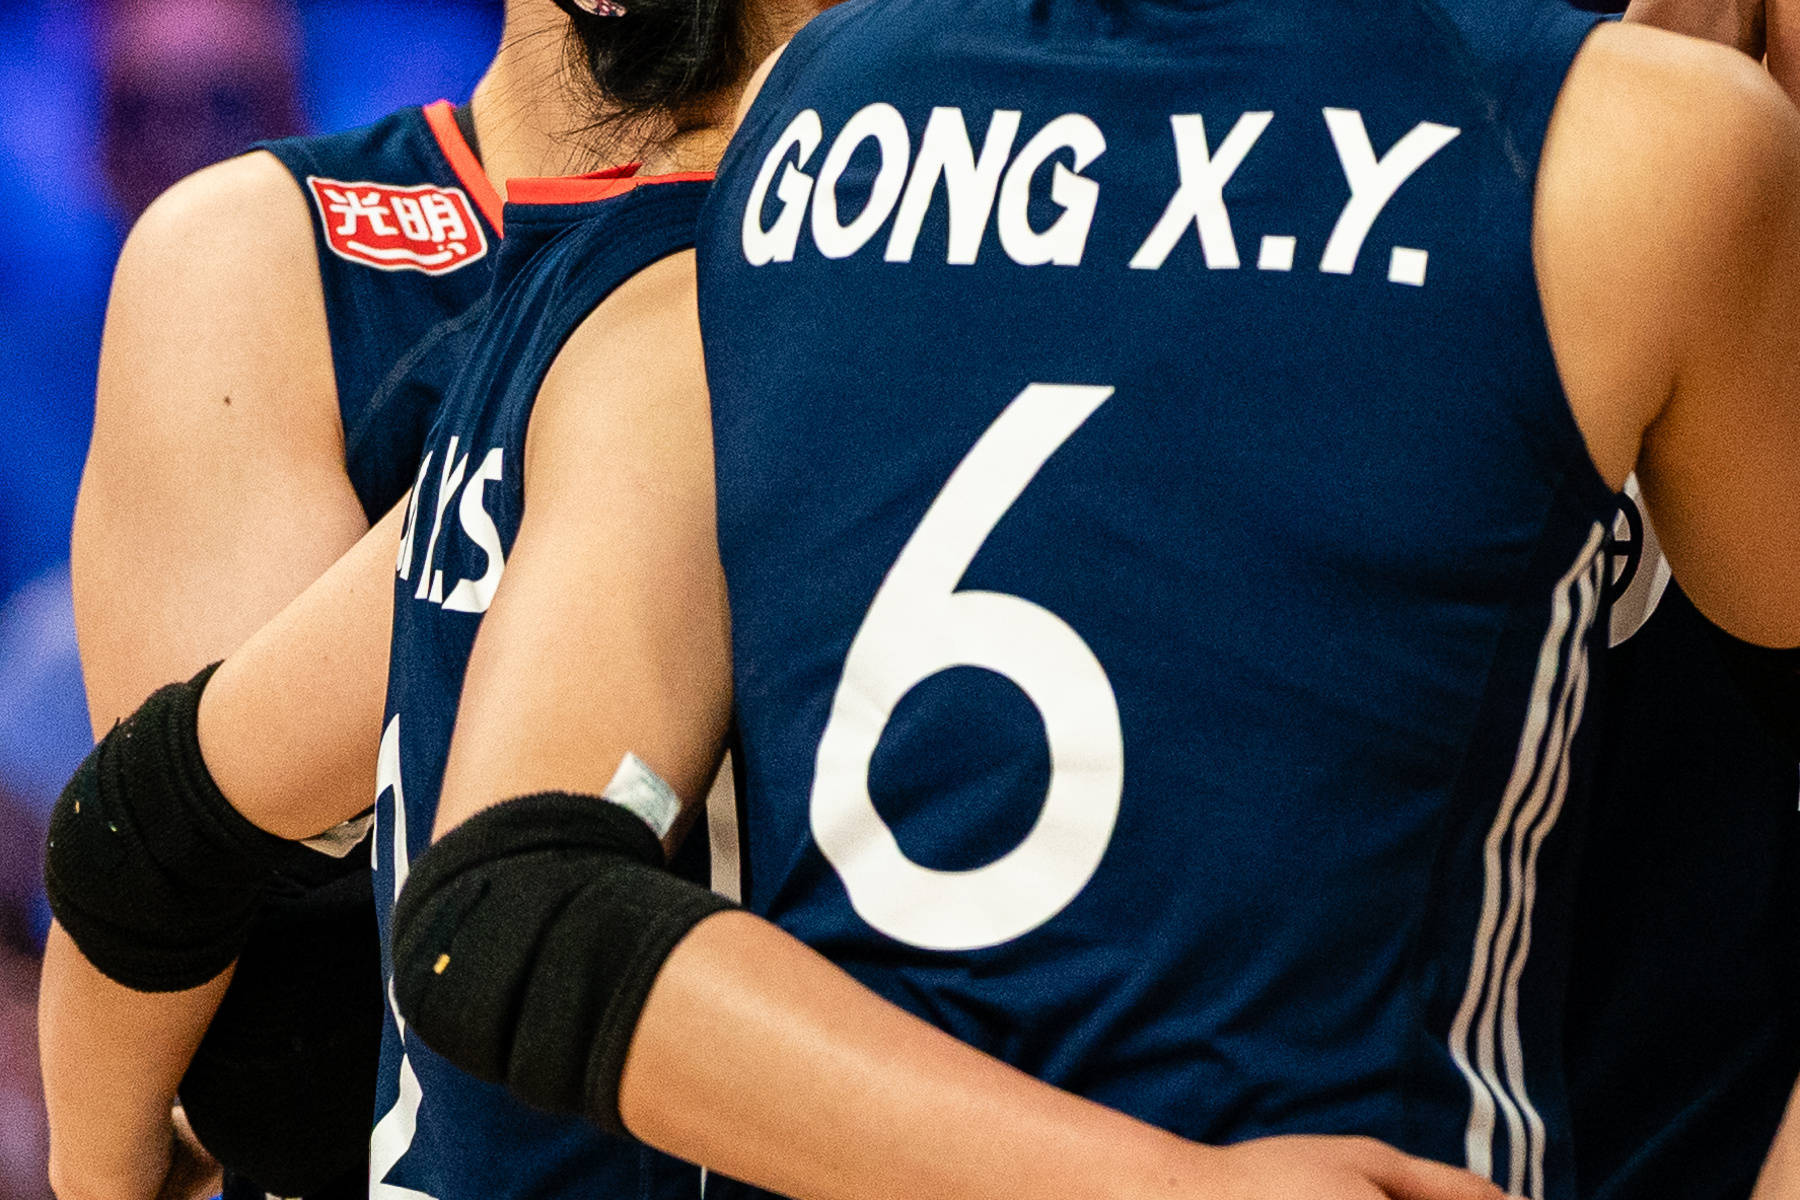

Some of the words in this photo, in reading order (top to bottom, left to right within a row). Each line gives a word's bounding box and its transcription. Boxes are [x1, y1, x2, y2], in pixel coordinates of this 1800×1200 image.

[323, 188, 468, 243] 光明
[741, 102, 1106, 267] GONG
[1128, 106, 1462, 287] X.Y.
[809, 382, 1124, 950] 6
